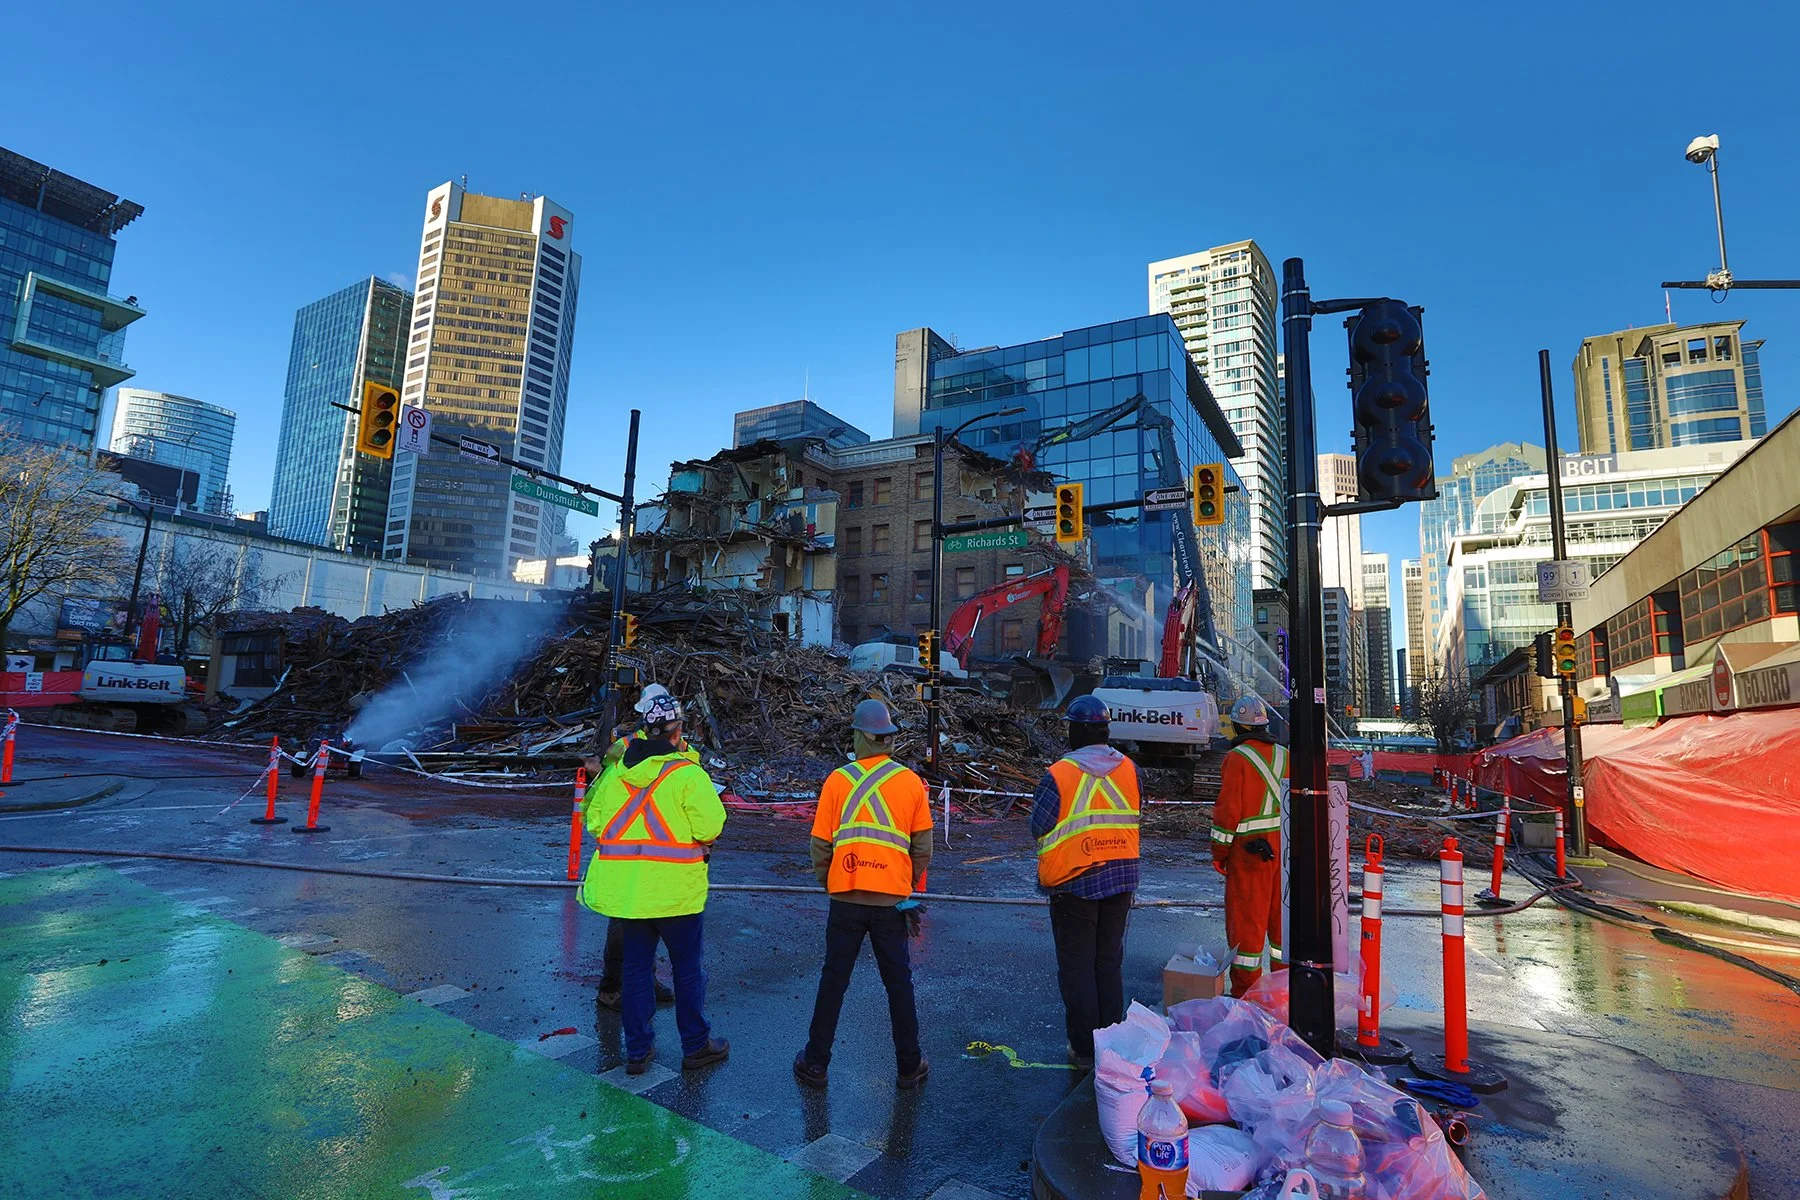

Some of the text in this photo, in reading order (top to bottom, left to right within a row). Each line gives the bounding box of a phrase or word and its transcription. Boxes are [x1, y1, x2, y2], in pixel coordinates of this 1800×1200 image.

[462, 440, 490, 454] ONE WAY
[1565, 457, 1613, 478] BCIT
[536, 486, 593, 513] Dunsmuir St.
[1032, 510, 1044, 518] ONE
[966, 535, 1019, 549] Richards St
[1543, 571, 1555, 581] 99
[1571, 570, 1577, 580] 1
[97, 676, 170, 691] Link-Belt
[1743, 666, 1791, 705] GOJIRO
[1680, 681, 1709, 711] RAMEN
[1109, 708, 1184, 726] Link-Belt
[1153, 1142, 1172, 1152] Pure
[1156, 1150, 1170, 1159] Life
